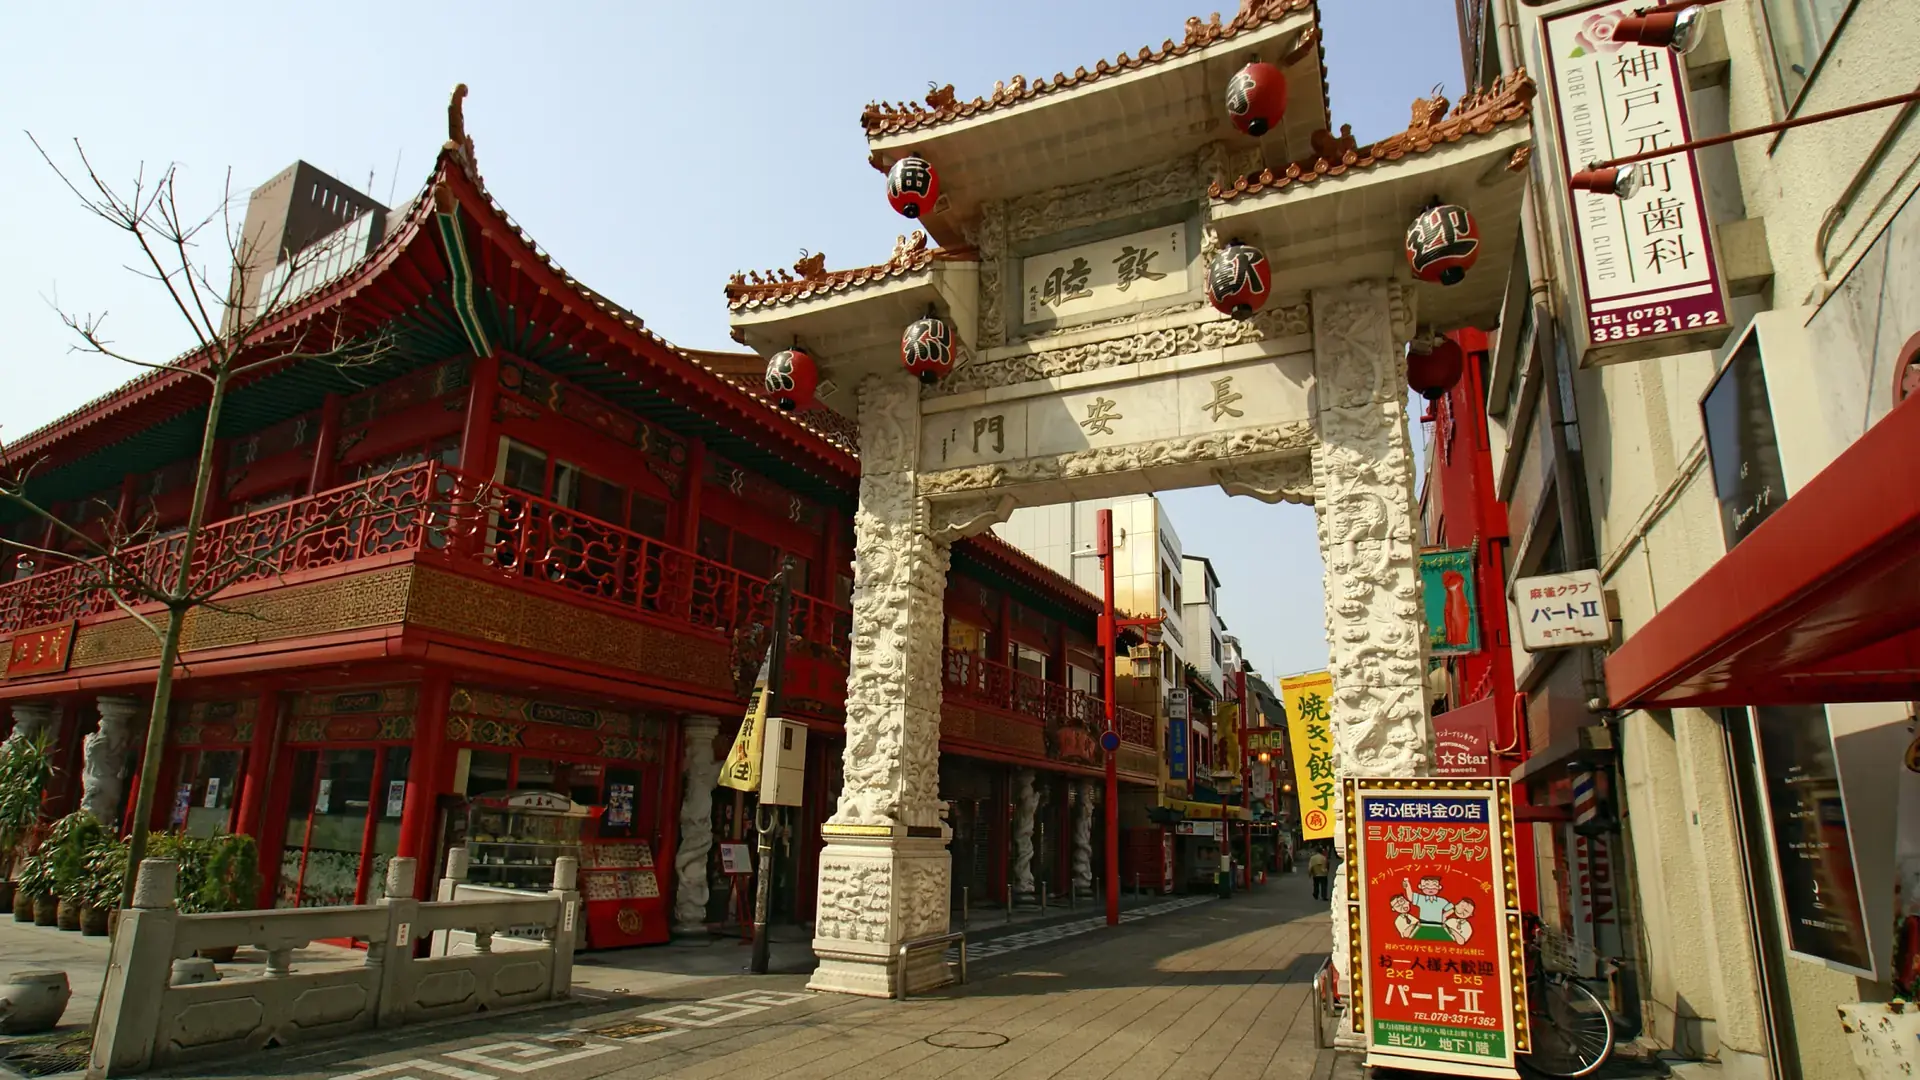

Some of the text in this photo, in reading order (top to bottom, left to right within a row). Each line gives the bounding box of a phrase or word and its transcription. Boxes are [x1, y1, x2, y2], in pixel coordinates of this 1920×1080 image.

[1566, 67, 1599, 166] KOBE MOTOMAC
[1612, 49, 1695, 275] 神戸元町歯科
[1406, 205, 1479, 272] 迎
[1593, 235, 1617, 281] CLINIC
[1590, 305, 1672, 326] TEL (078)
[1593, 310, 1720, 342] 335-2122
[1530, 582, 1592, 600] 麻雀クラブ
[1543, 628, 1562, 638] 地下
[1298, 692, 1335, 811] 焼き餃子
[1458, 752, 1488, 765] Star
[1369, 803, 1481, 819] 安心低料金の店
[1385, 842, 1489, 861] ルールマージャン
[1388, 1032, 1427, 1048] 当ビル
